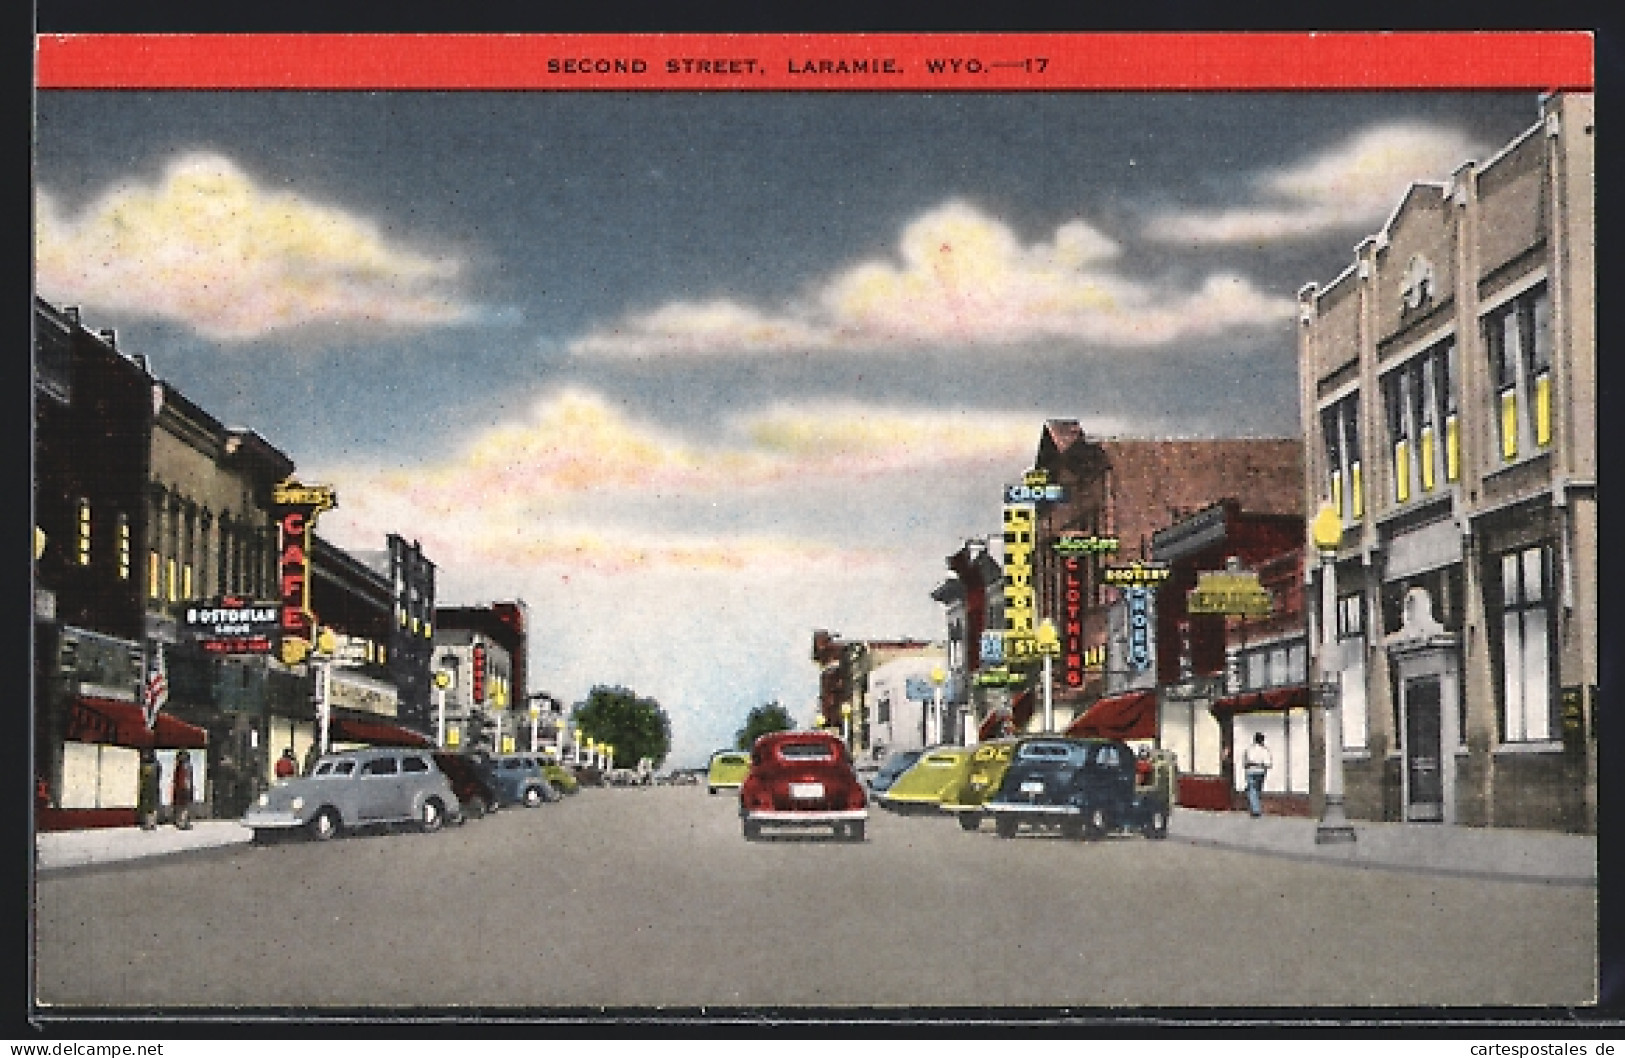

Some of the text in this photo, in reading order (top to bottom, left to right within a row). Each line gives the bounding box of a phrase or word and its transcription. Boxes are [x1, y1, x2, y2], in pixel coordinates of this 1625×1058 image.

[547, 58, 648, 74] SECOND
[665, 58, 766, 75] STREET,
[283, 513, 304, 627] CAFE
[186, 608, 275, 624] BOSTONIAN
[1066, 559, 1082, 684] CLOTHING
